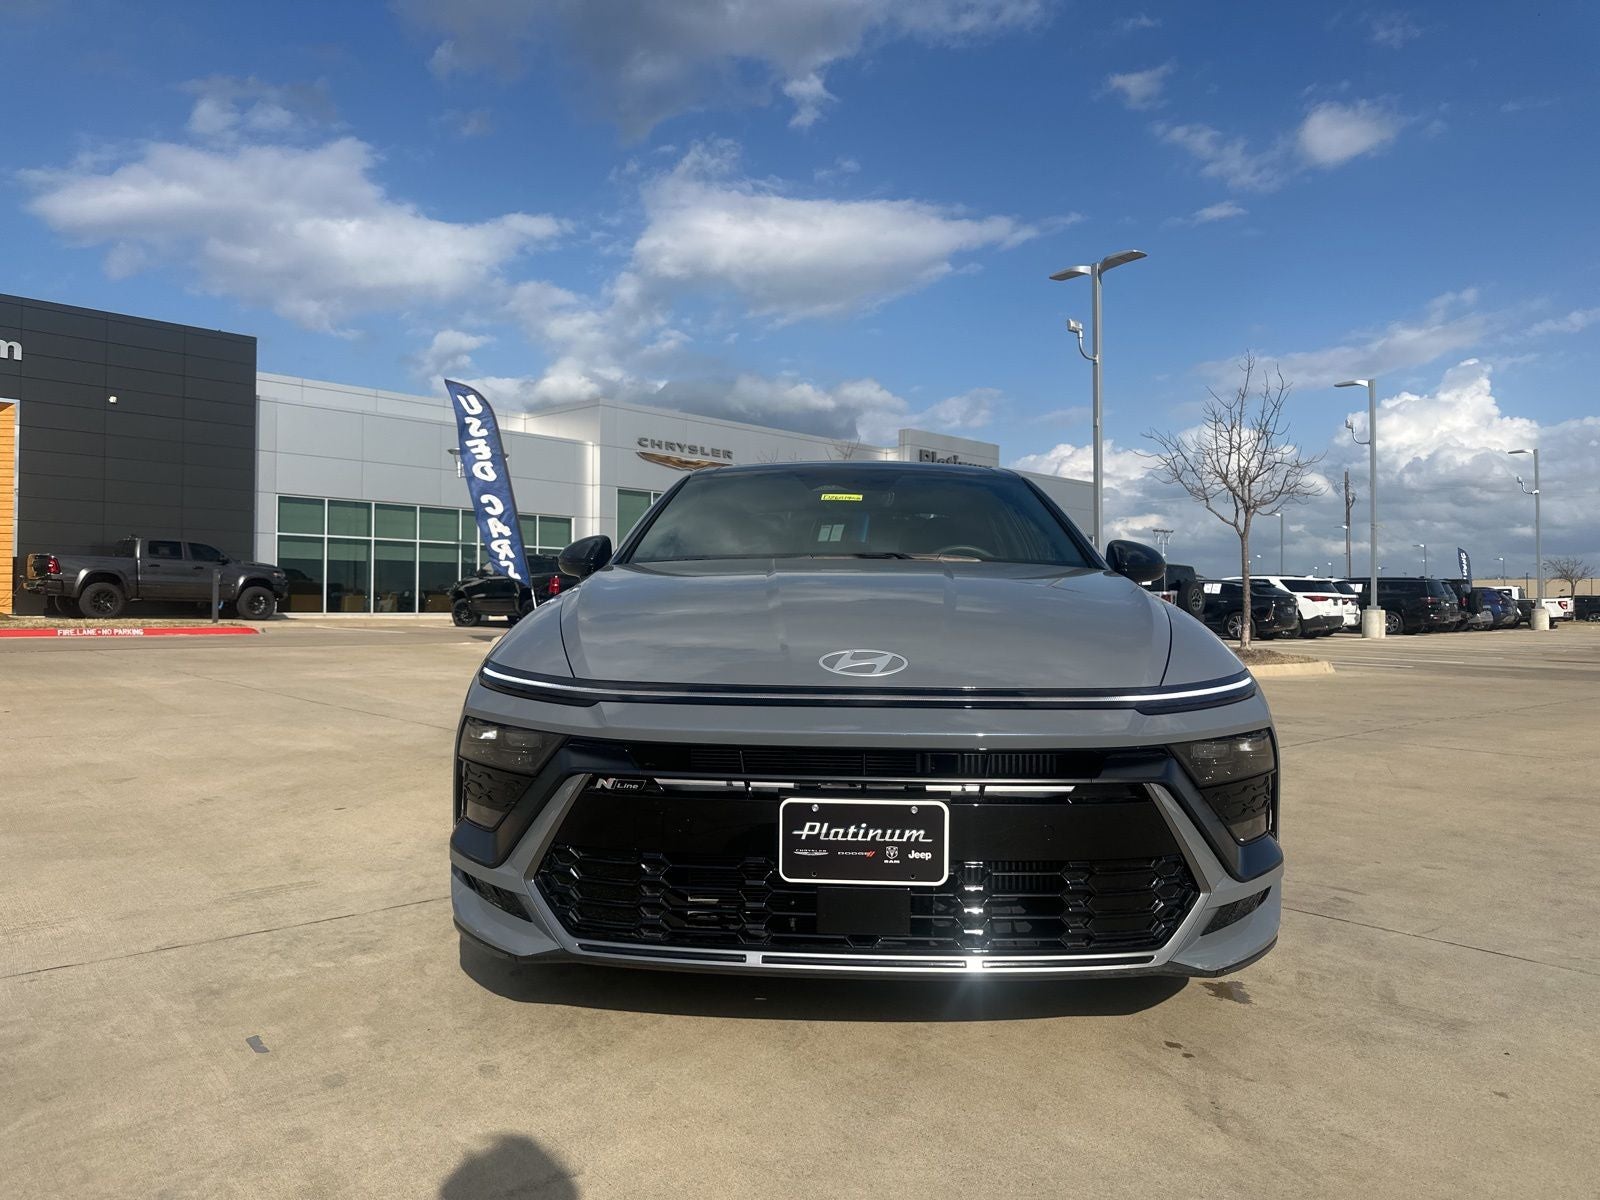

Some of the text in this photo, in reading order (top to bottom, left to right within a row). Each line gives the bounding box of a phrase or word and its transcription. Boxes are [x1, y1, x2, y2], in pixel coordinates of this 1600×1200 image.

[637, 437, 734, 460] CHRYSLER
[57, 628, 76, 636] FIRE
[76, 628, 97, 636] LANE
[101, 628, 113, 636] NO
[113, 628, 144, 636] PARKING
[595, 778, 616, 790] N
[792, 822, 933, 843] Platinum
[907, 849, 932, 861] Jeep
